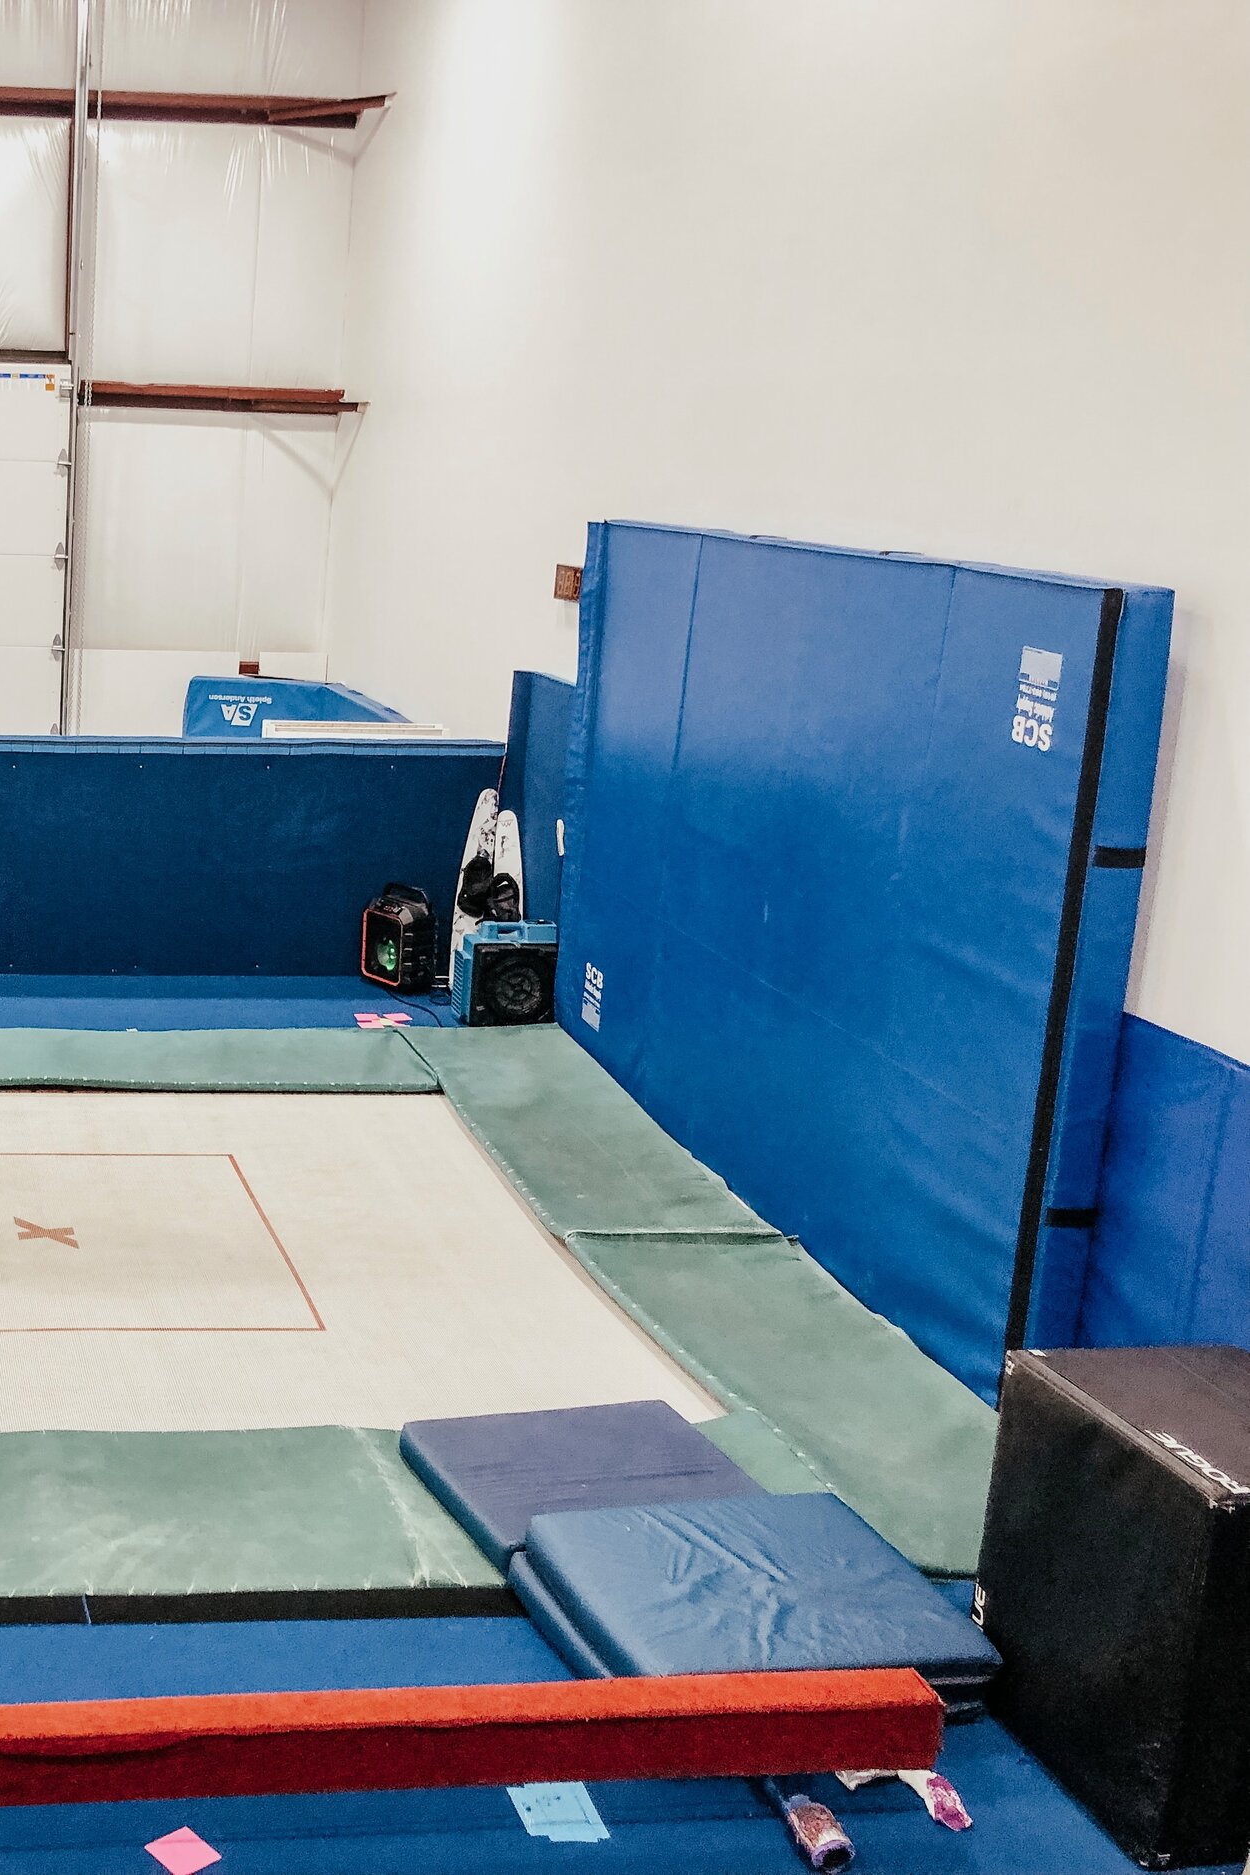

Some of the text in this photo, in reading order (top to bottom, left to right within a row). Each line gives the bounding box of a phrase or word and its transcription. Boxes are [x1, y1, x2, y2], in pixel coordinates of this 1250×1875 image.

[208, 694, 246, 703] Anderson
[221, 703, 258, 726] SA
[1012, 714, 1053, 752] SCB
[585, 962, 604, 989] SCB
[1144, 1429, 1250, 1494] ROGUE
